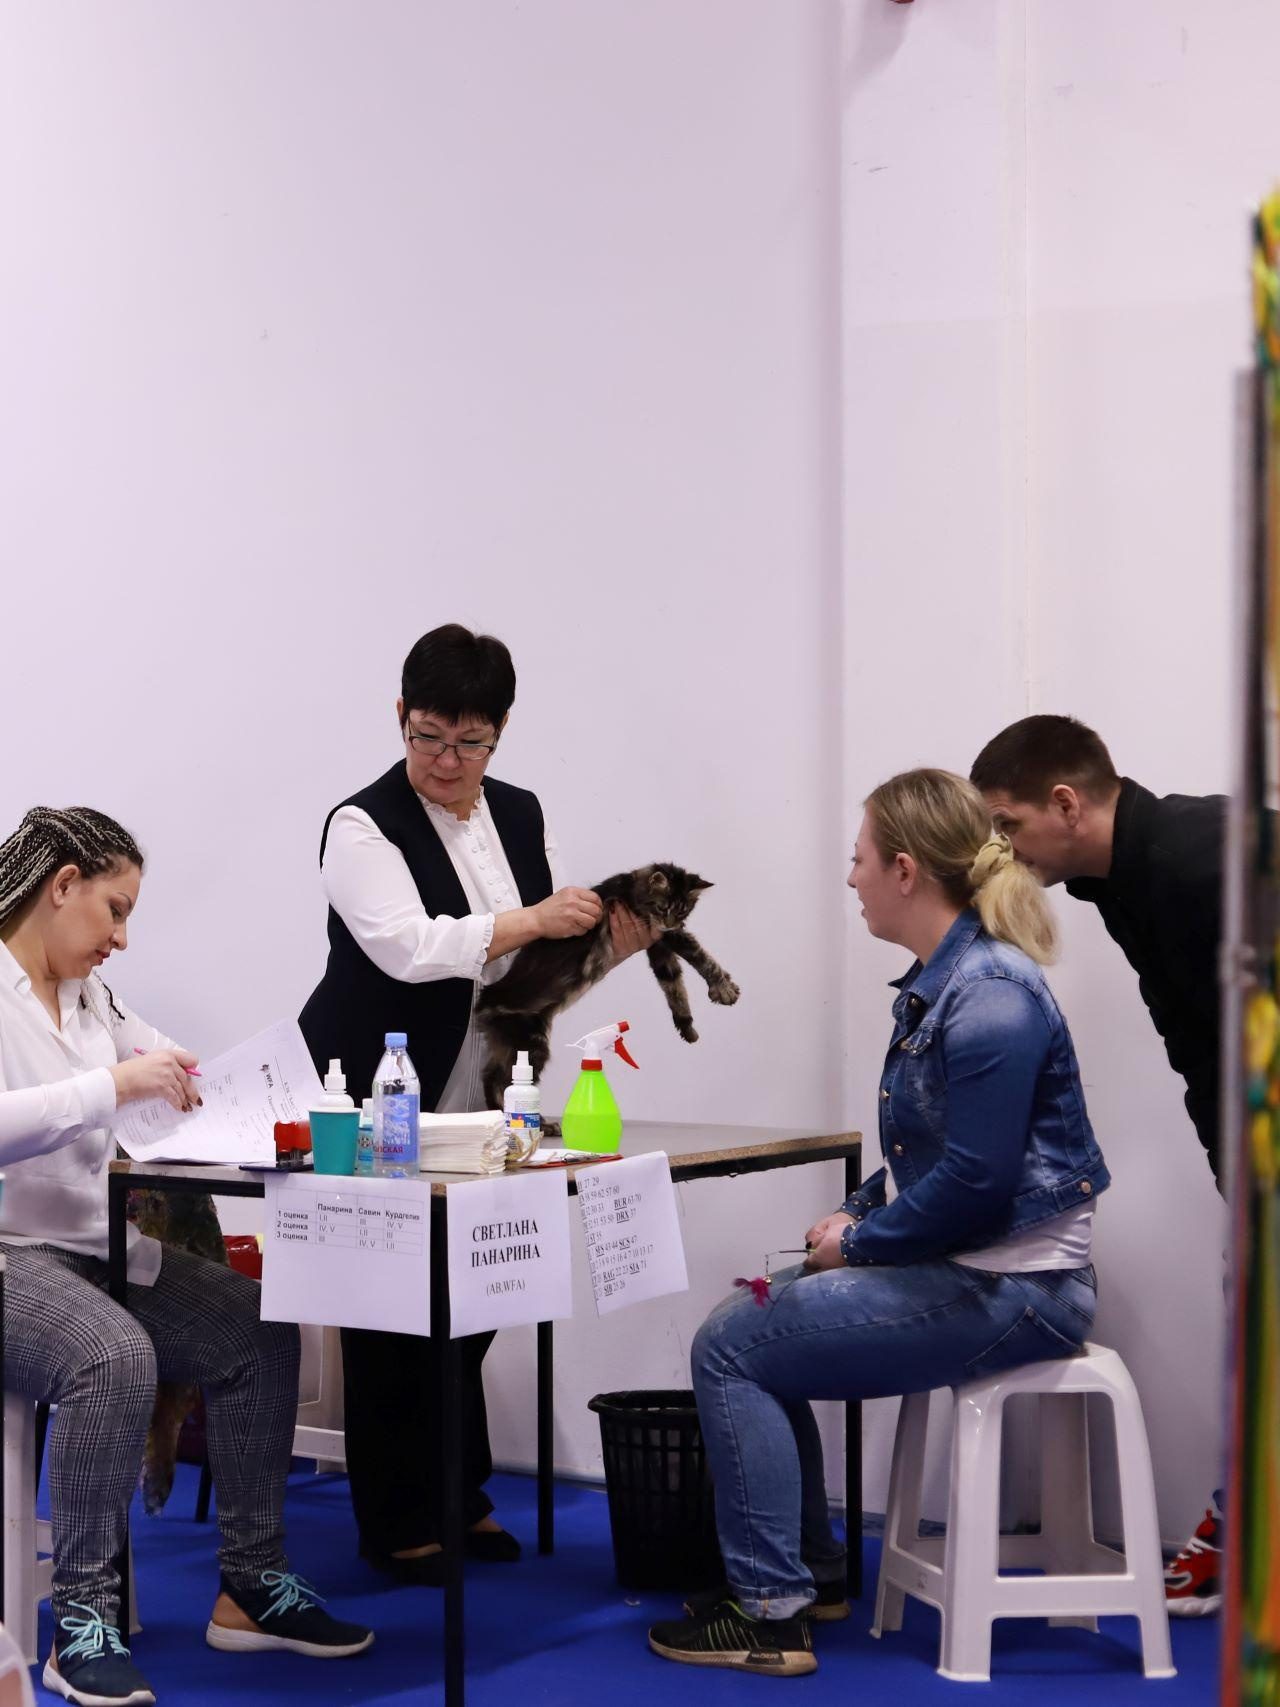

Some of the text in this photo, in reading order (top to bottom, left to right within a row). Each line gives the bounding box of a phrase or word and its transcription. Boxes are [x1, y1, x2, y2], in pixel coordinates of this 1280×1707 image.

[318, 1203, 353, 1214] Панарина
[358, 1208, 381, 1216] Савин
[614, 1197, 627, 1210] BUR
[616, 1209, 629, 1223] DRX
[472, 1219, 538, 1242] СВЕТЛАНА
[471, 1244, 540, 1268] ПАНАРИНА
[486, 1279, 526, 1296] (AB,WFA)
